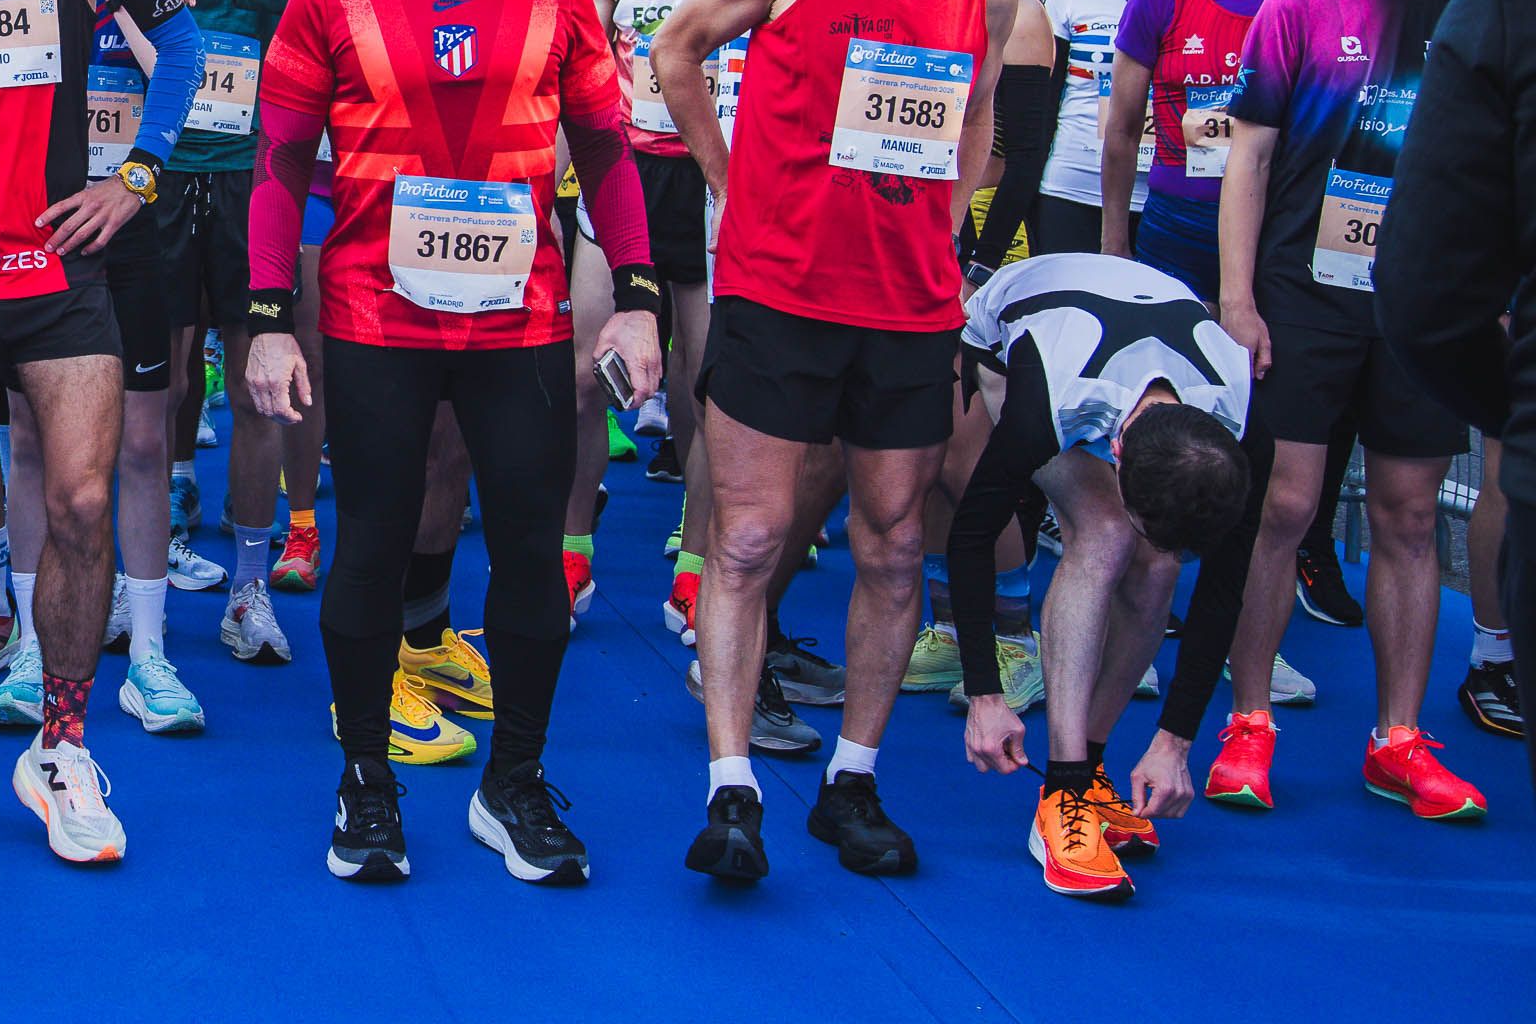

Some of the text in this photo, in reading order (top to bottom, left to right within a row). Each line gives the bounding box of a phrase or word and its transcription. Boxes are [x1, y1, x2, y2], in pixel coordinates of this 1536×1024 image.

[852, 44, 917, 65] ProFuturo
[868, 77, 899, 88] Carrera
[899, 81, 938, 93] ProFuturo
[1183, 73, 1216, 85] A.D.
[865, 93, 946, 129] 31583
[881, 138, 924, 155] MANUEL
[880, 162, 905, 171] MADRID
[398, 180, 469, 200] ProFuturo
[1347, 204, 1379, 215] Carrera
[417, 213, 451, 223] Carrera
[452, 216, 496, 226] ProFuturo
[496, 218, 517, 226] 2026
[417, 230, 509, 263] 31867
[436, 299, 464, 308] MADRID
